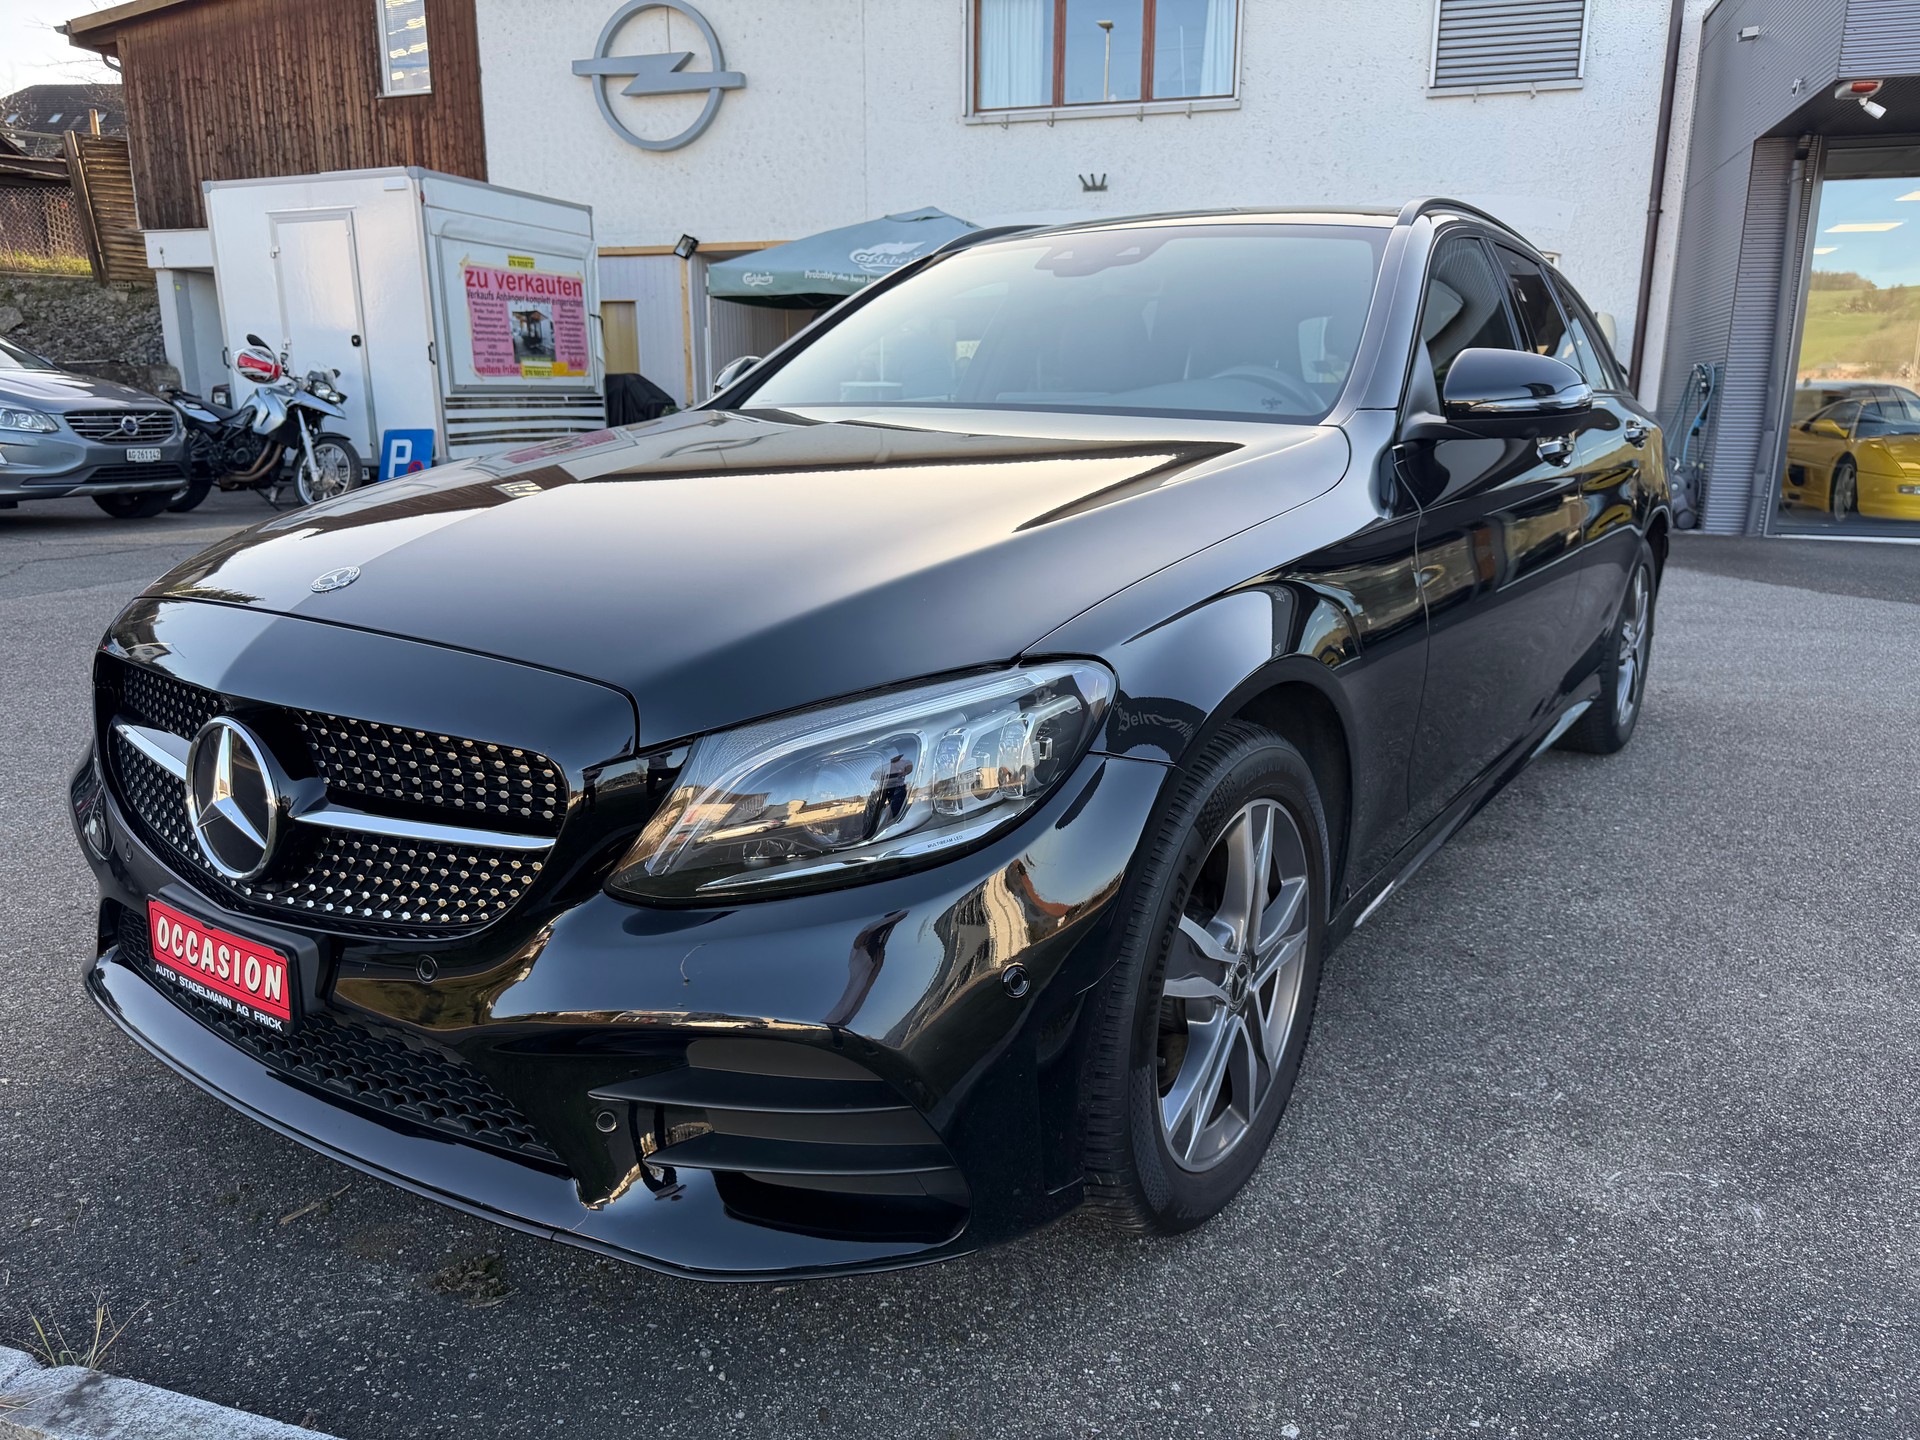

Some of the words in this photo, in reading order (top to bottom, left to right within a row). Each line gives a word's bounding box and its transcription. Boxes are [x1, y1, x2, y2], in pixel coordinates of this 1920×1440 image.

[494, 272, 583, 297] verkaufen
[805, 270, 836, 282] Probably
[837, 273, 849, 281] the
[850, 273, 866, 283] best
[467, 289, 494, 301] Verkaufs
[388, 438, 413, 478] P
[927, 838, 954, 848] MULTIBEAM
[157, 915, 284, 1002] OCCASION
[155, 964, 177, 982] AUTO
[180, 975, 232, 1010] STADELMANN
[236, 1003, 250, 1018] AG
[254, 1011, 283, 1032] FRICK
